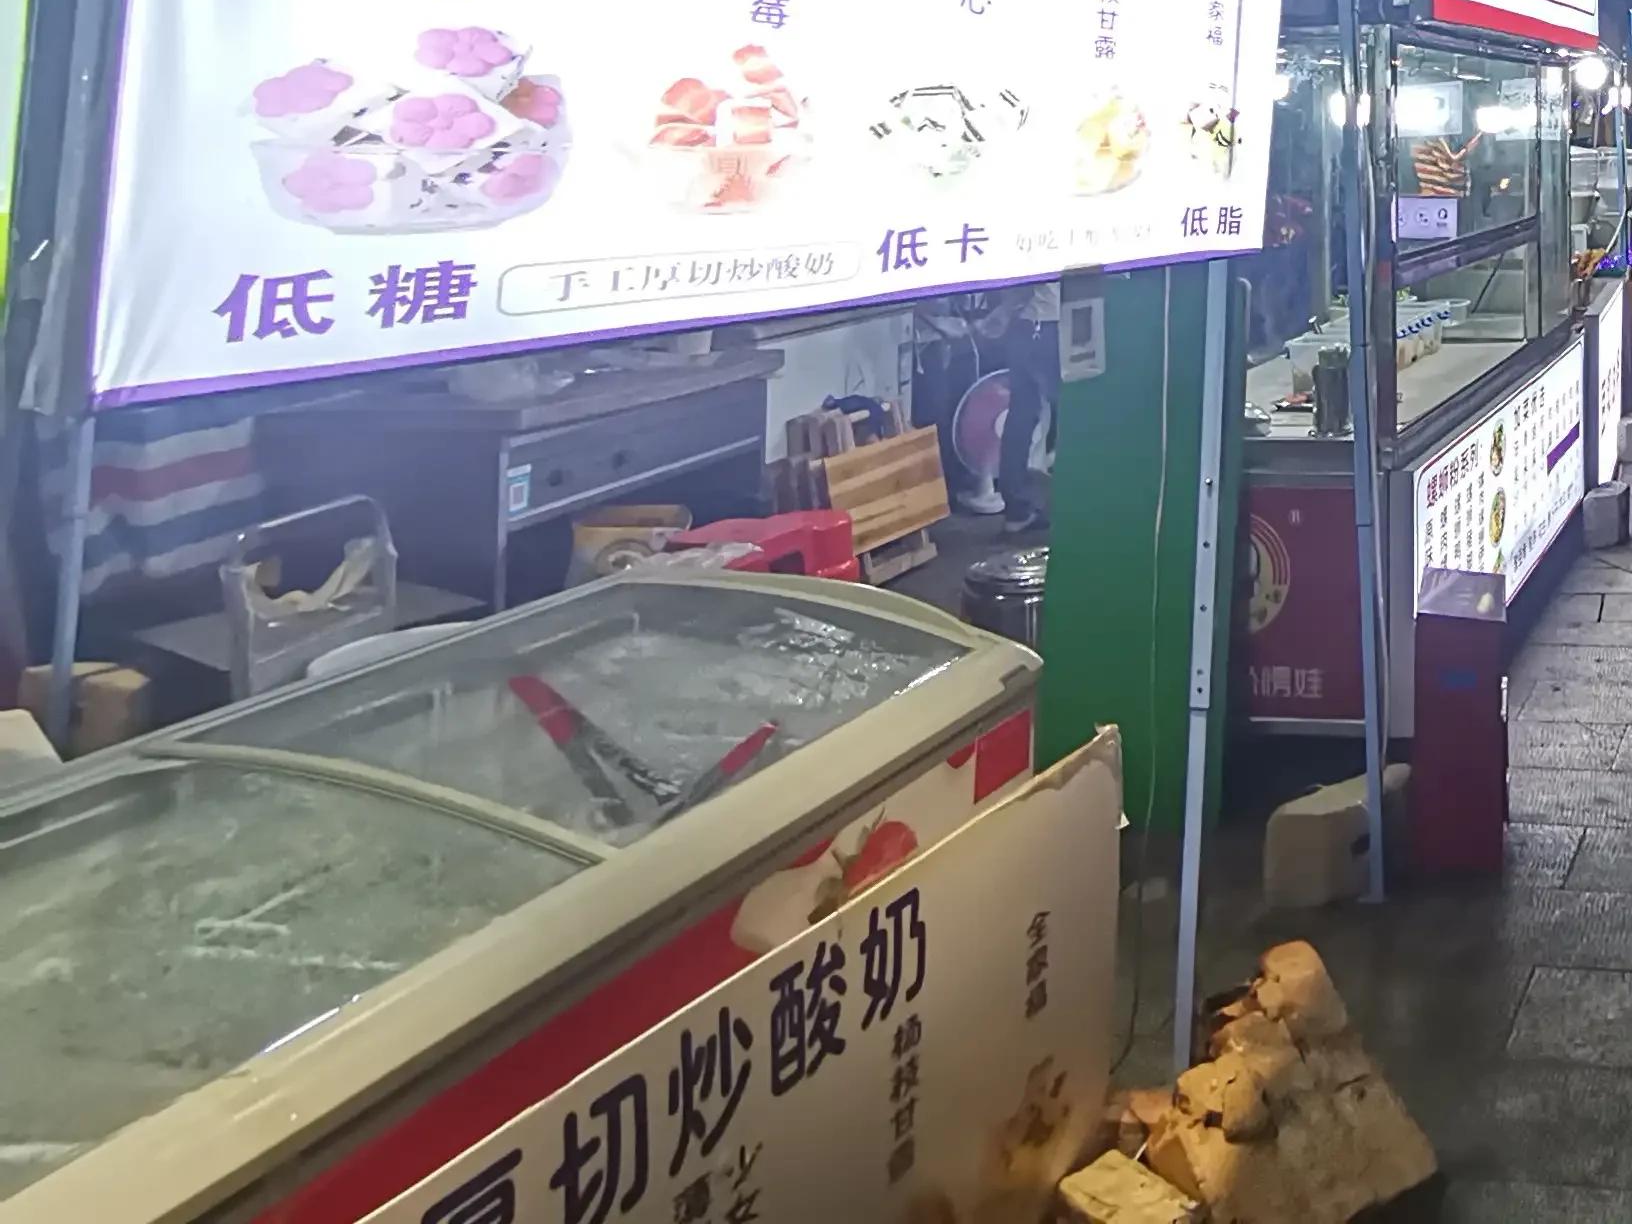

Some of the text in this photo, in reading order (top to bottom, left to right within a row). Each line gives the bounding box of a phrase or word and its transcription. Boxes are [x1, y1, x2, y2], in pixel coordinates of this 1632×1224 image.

[1180, 206, 1243, 237] 低脂
[877, 223, 989, 272] 低卡
[211, 260, 478, 343] 低糖
